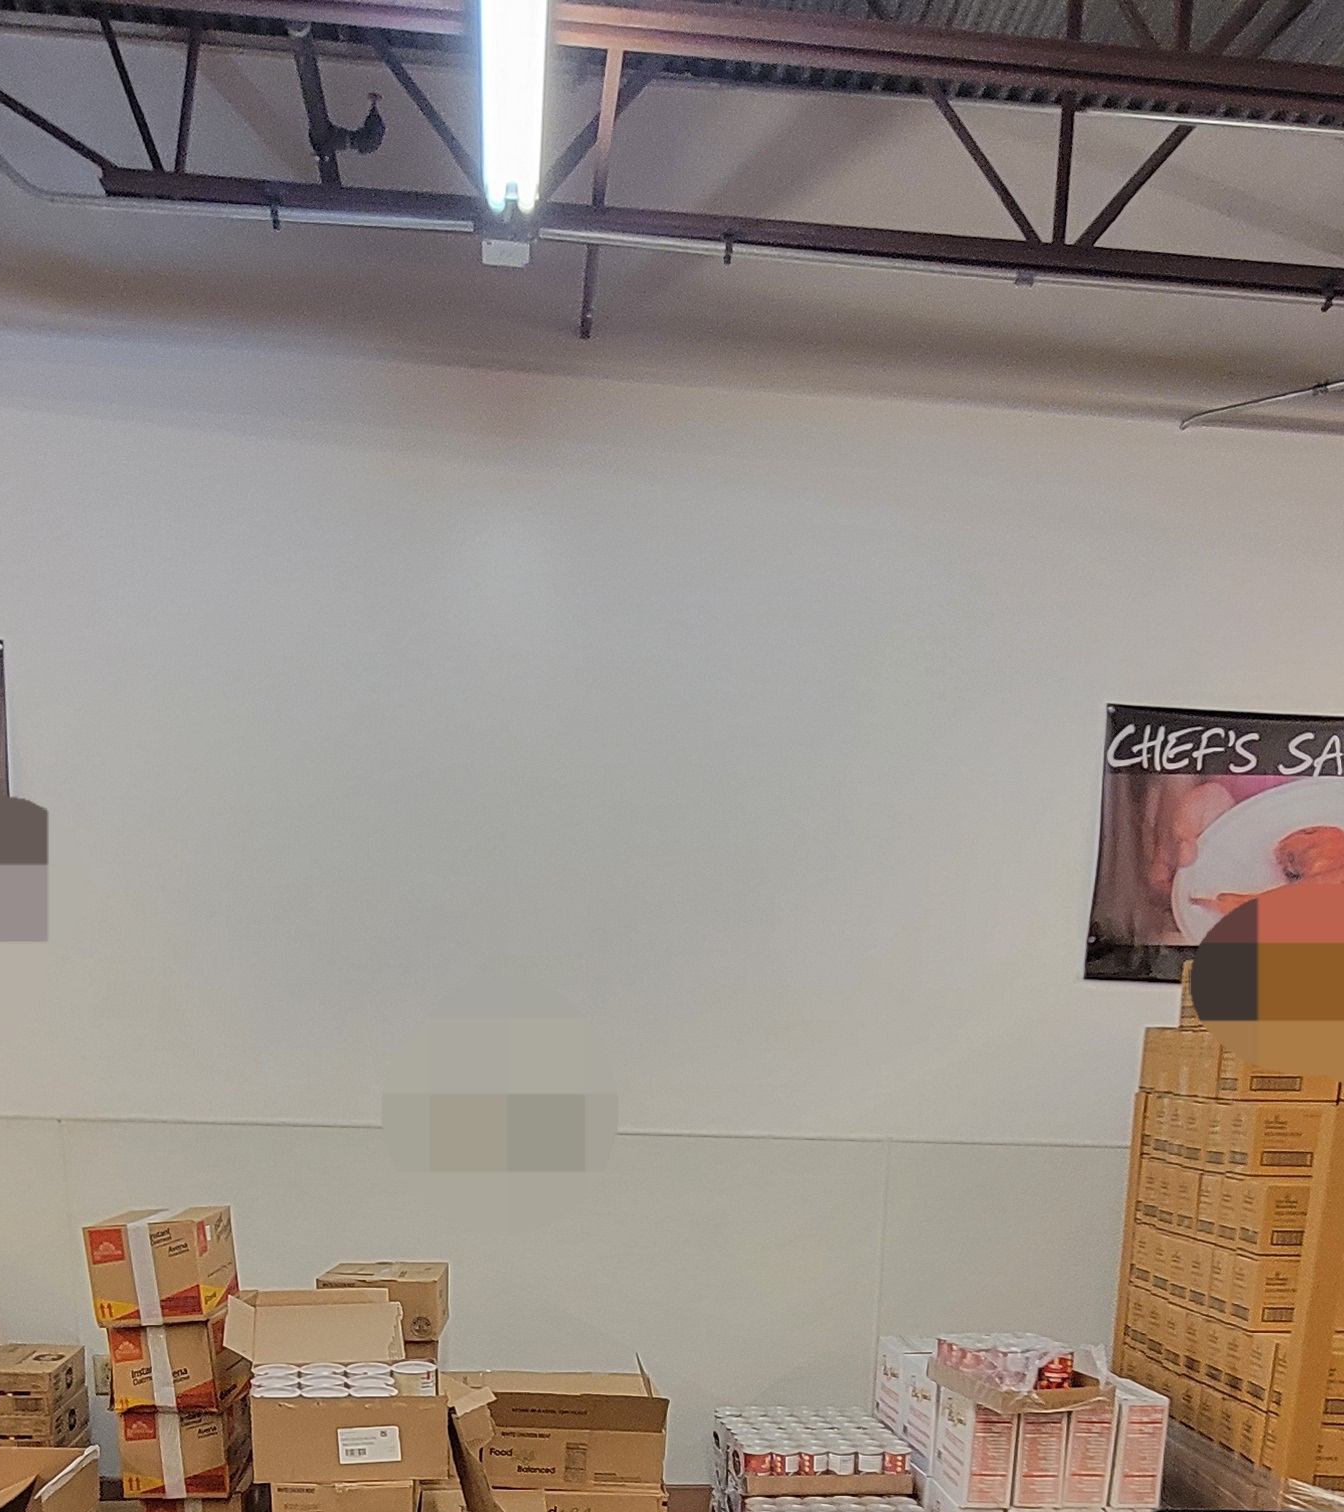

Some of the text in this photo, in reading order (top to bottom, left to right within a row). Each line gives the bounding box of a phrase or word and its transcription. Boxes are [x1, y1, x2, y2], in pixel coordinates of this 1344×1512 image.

[1107, 724, 1260, 773] CHEF'S
[131, 1366, 153, 1379] Insta
[172, 1367, 188, 1378] ena
[489, 1447, 513, 1458] Food
[516, 1465, 556, 1475] Balanced
